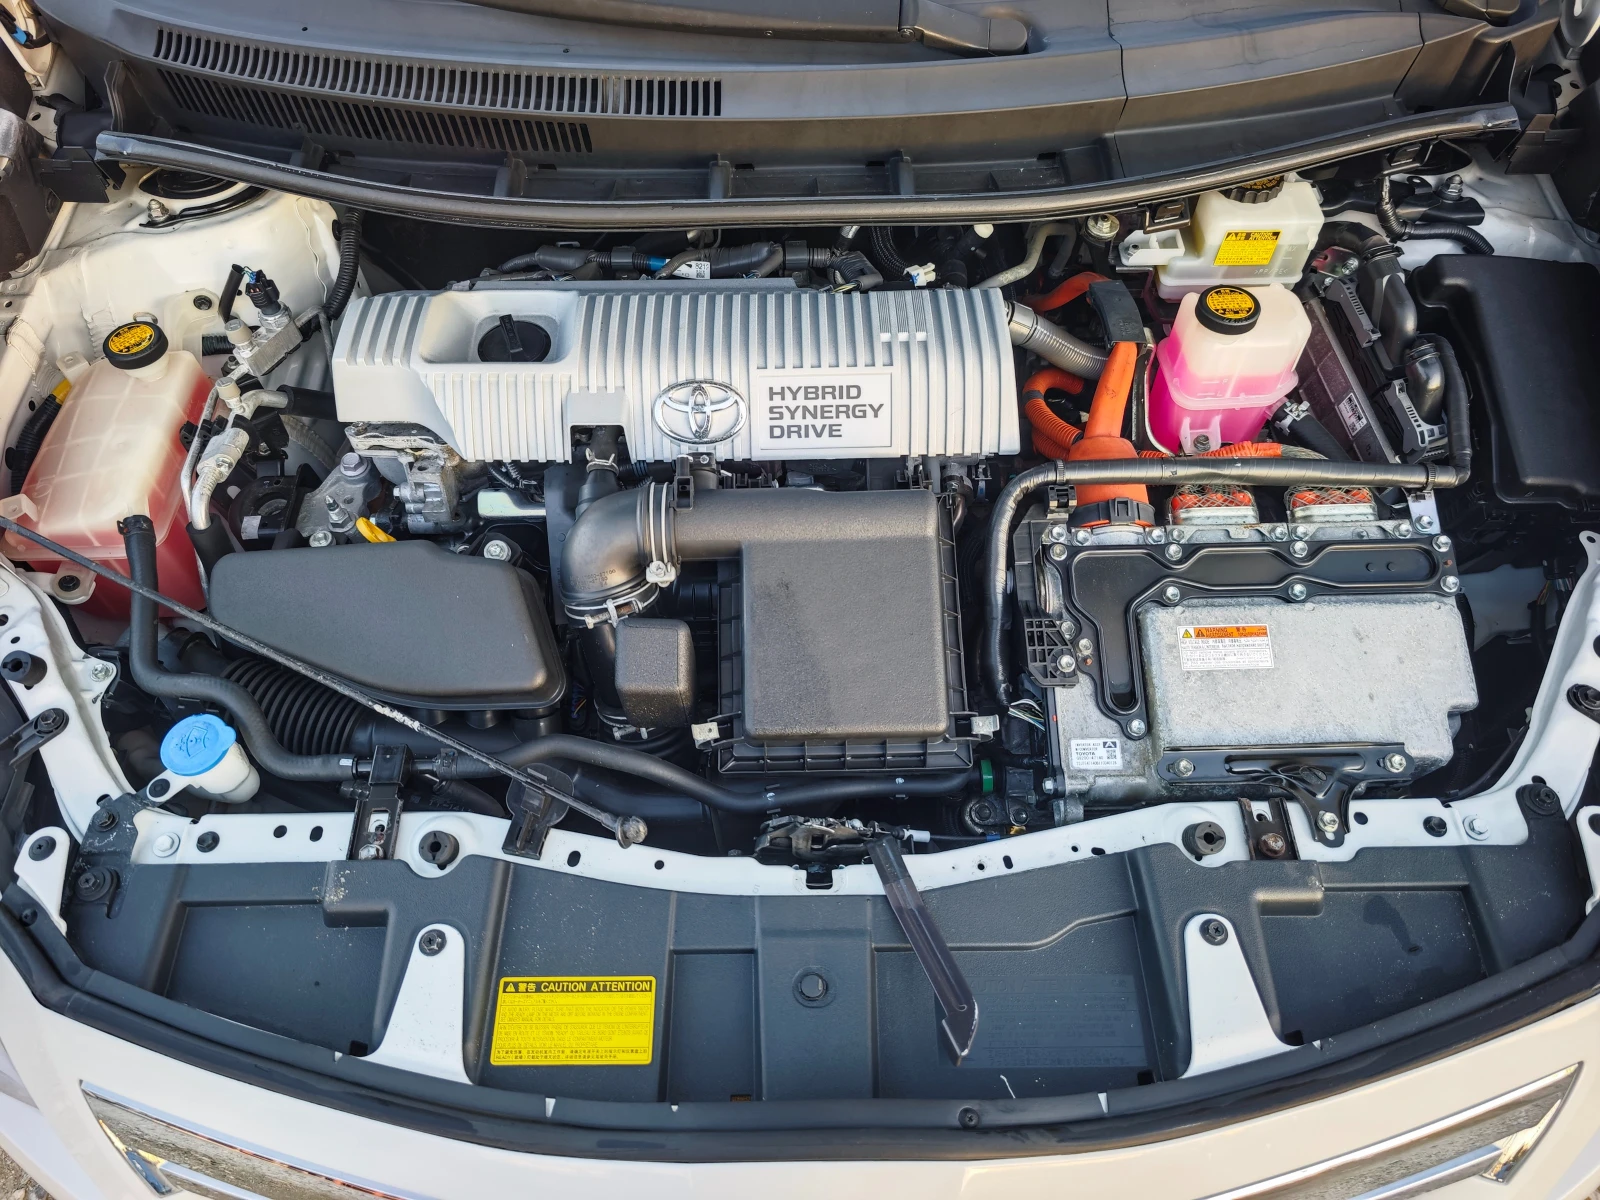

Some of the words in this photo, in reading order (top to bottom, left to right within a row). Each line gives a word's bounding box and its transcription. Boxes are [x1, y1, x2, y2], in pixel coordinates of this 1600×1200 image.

[768, 384, 862, 401] HYBRID
[768, 403, 885, 421] SYNERGY
[769, 424, 843, 439] DRIVE
[541, 981, 587, 992] CAUTION
[590, 981, 651, 992] ATTENTION
